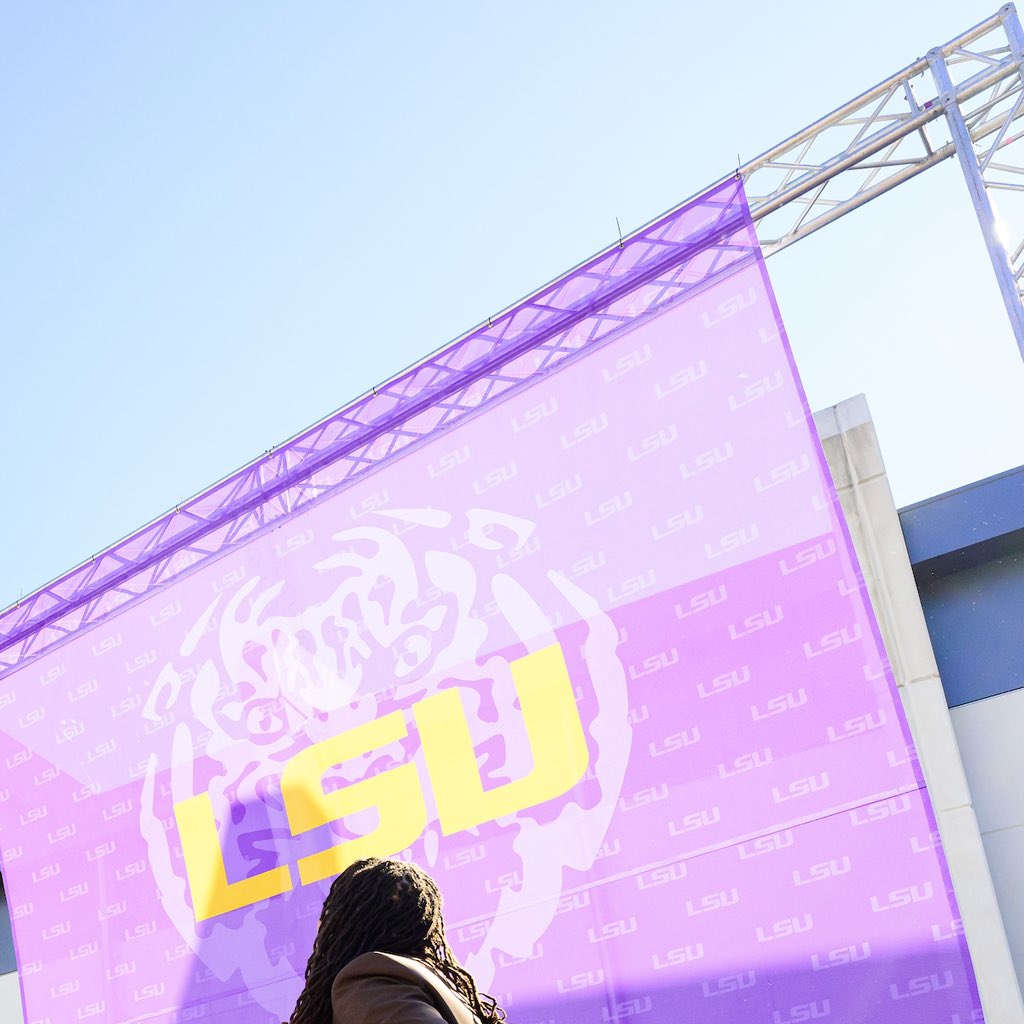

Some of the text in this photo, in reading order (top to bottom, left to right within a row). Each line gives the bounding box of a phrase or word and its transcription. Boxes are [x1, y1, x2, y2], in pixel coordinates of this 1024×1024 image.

[702, 287, 756, 328] LSU
[655, 360, 707, 399] LSU
[511, 398, 558, 432] LSU
[627, 424, 678, 462] LSU
[754, 454, 810, 492] LSU
[535, 474, 582, 508] LSU
[651, 505, 703, 540] LSU
[779, 541, 835, 575] LSU
[728, 606, 784, 640] LSU
[630, 648, 679, 679] LSU
[19, 707, 45, 728] LSU
[751, 689, 807, 720] LSU
[87, 739, 116, 761] LSU
[649, 727, 700, 757] LSU
[174, 641, 589, 924] LSU
[772, 772, 829, 803] LSU
[20, 805, 47, 826] LSU
[48, 824, 76, 844] LSU
[116, 860, 145, 880] LSU
[793, 856, 851, 886] LSU
[60, 882, 88, 901] LSU
[870, 882, 933, 912] LSU
[126, 922, 156, 940] LSU
[756, 914, 813, 942] LSU
[107, 961, 136, 980] LSU
[811, 942, 870, 971] LSU
[134, 982, 165, 1001] LSU
[703, 971, 756, 997] LSU
[602, 997, 652, 1021] LSU
